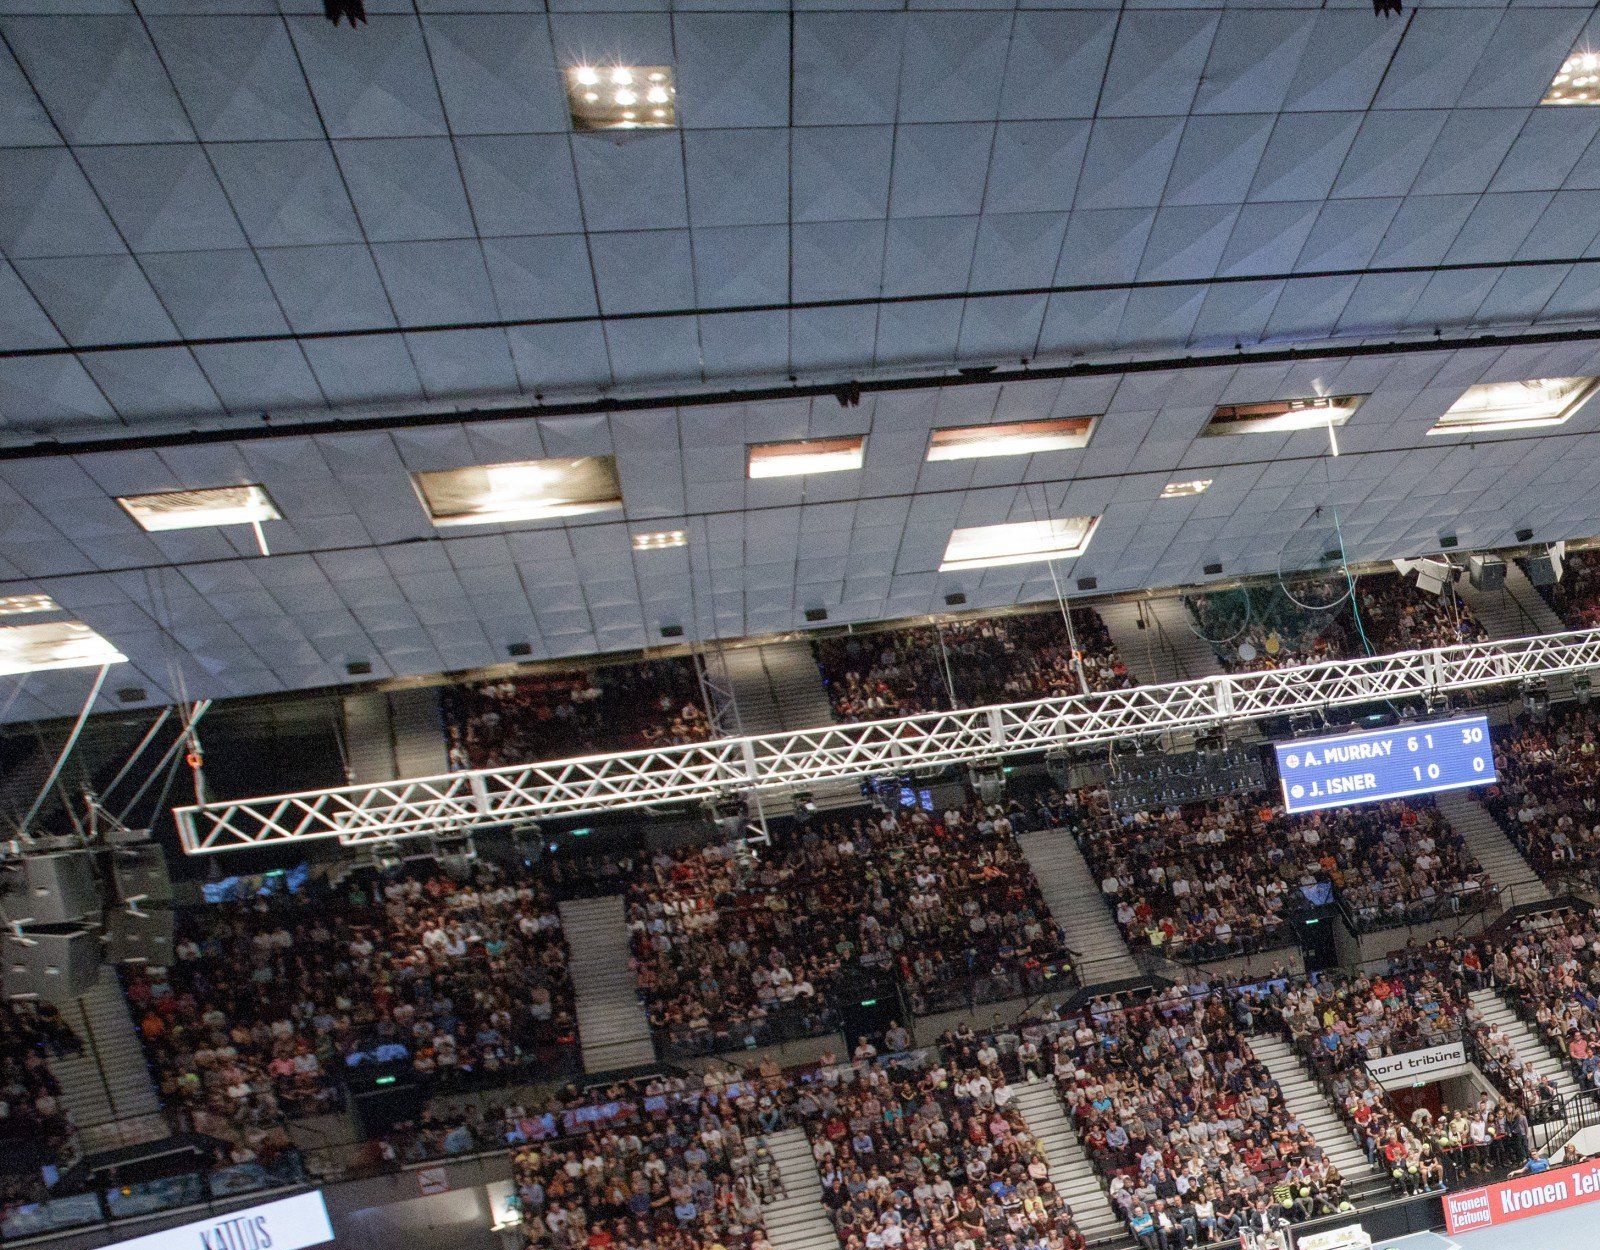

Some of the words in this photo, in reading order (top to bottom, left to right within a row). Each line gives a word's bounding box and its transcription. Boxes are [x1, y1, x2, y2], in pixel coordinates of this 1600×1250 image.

[1304, 751, 1322, 767] A.
[1324, 740, 1393, 764] MURRAY
[1407, 736, 1419, 752] 6
[1425, 734, 1433, 748] 1
[1461, 727, 1483, 744] 30
[1309, 782, 1324, 798] J.
[1327, 772, 1377, 795] ISNER
[1413, 766, 1421, 782] 1
[1428, 764, 1440, 779] 0
[1472, 756, 1485, 772] 0
[1370, 1061, 1403, 1076] nord
[1408, 1051, 1461, 1068] tribüne
[1450, 1195, 1488, 1213] Kronen
[1500, 1180, 1568, 1214] Kronen
[1453, 1208, 1490, 1228] Zeitung
